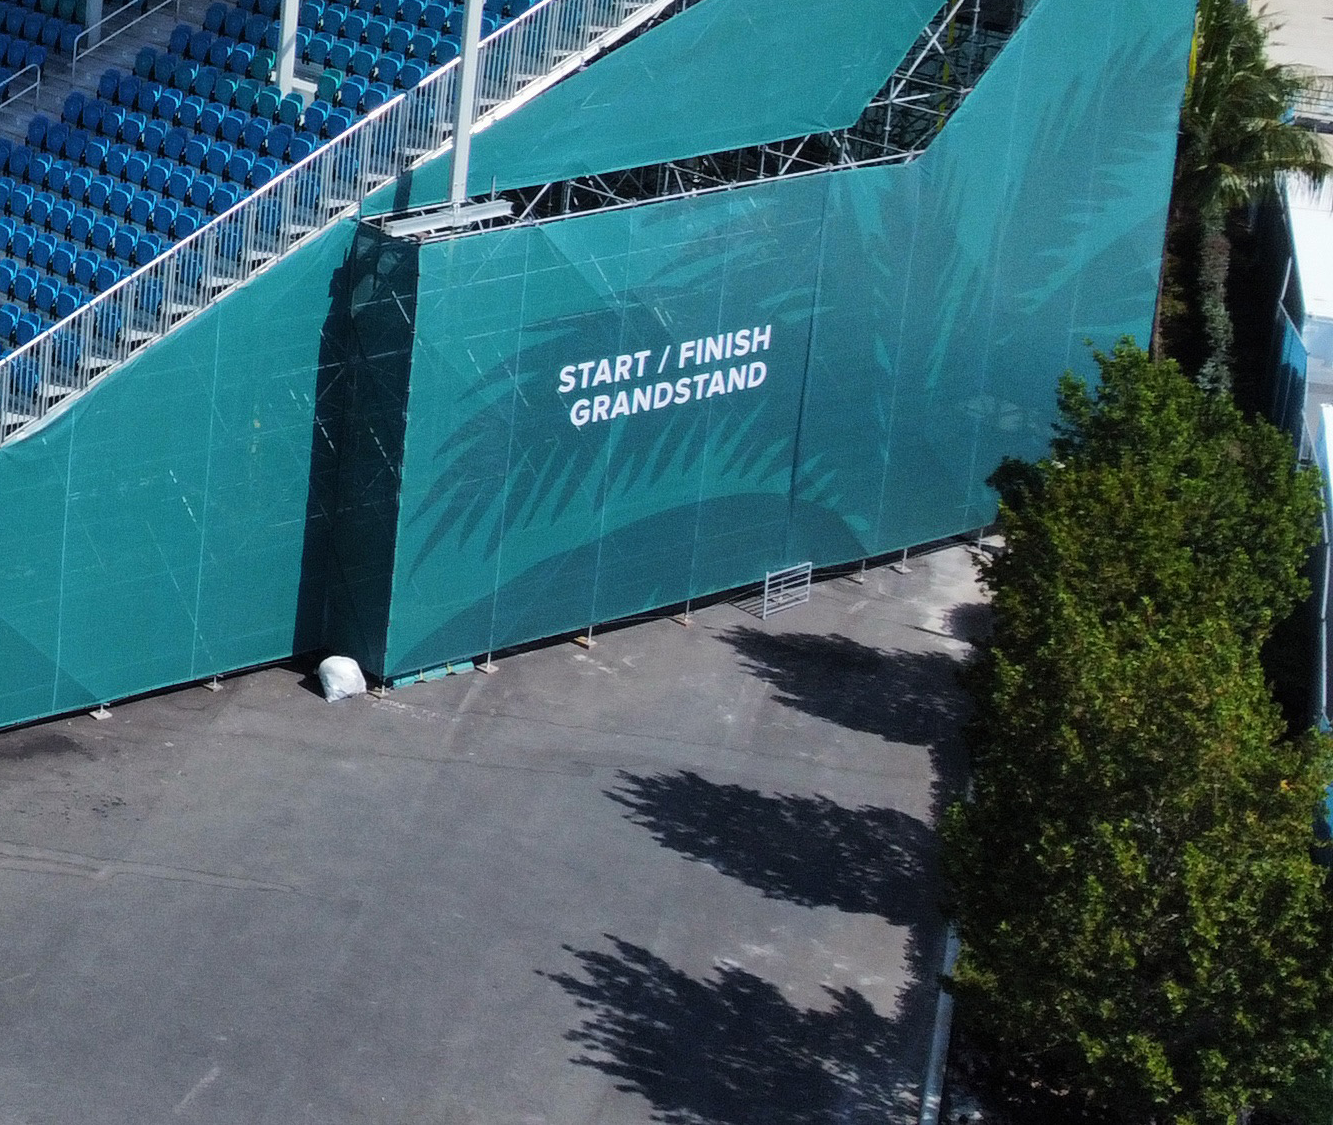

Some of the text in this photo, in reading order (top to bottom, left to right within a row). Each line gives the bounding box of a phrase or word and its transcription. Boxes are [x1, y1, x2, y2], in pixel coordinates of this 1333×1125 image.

[557, 324, 773, 394] START / FINISH
[569, 361, 768, 427] GRANDSTAND
